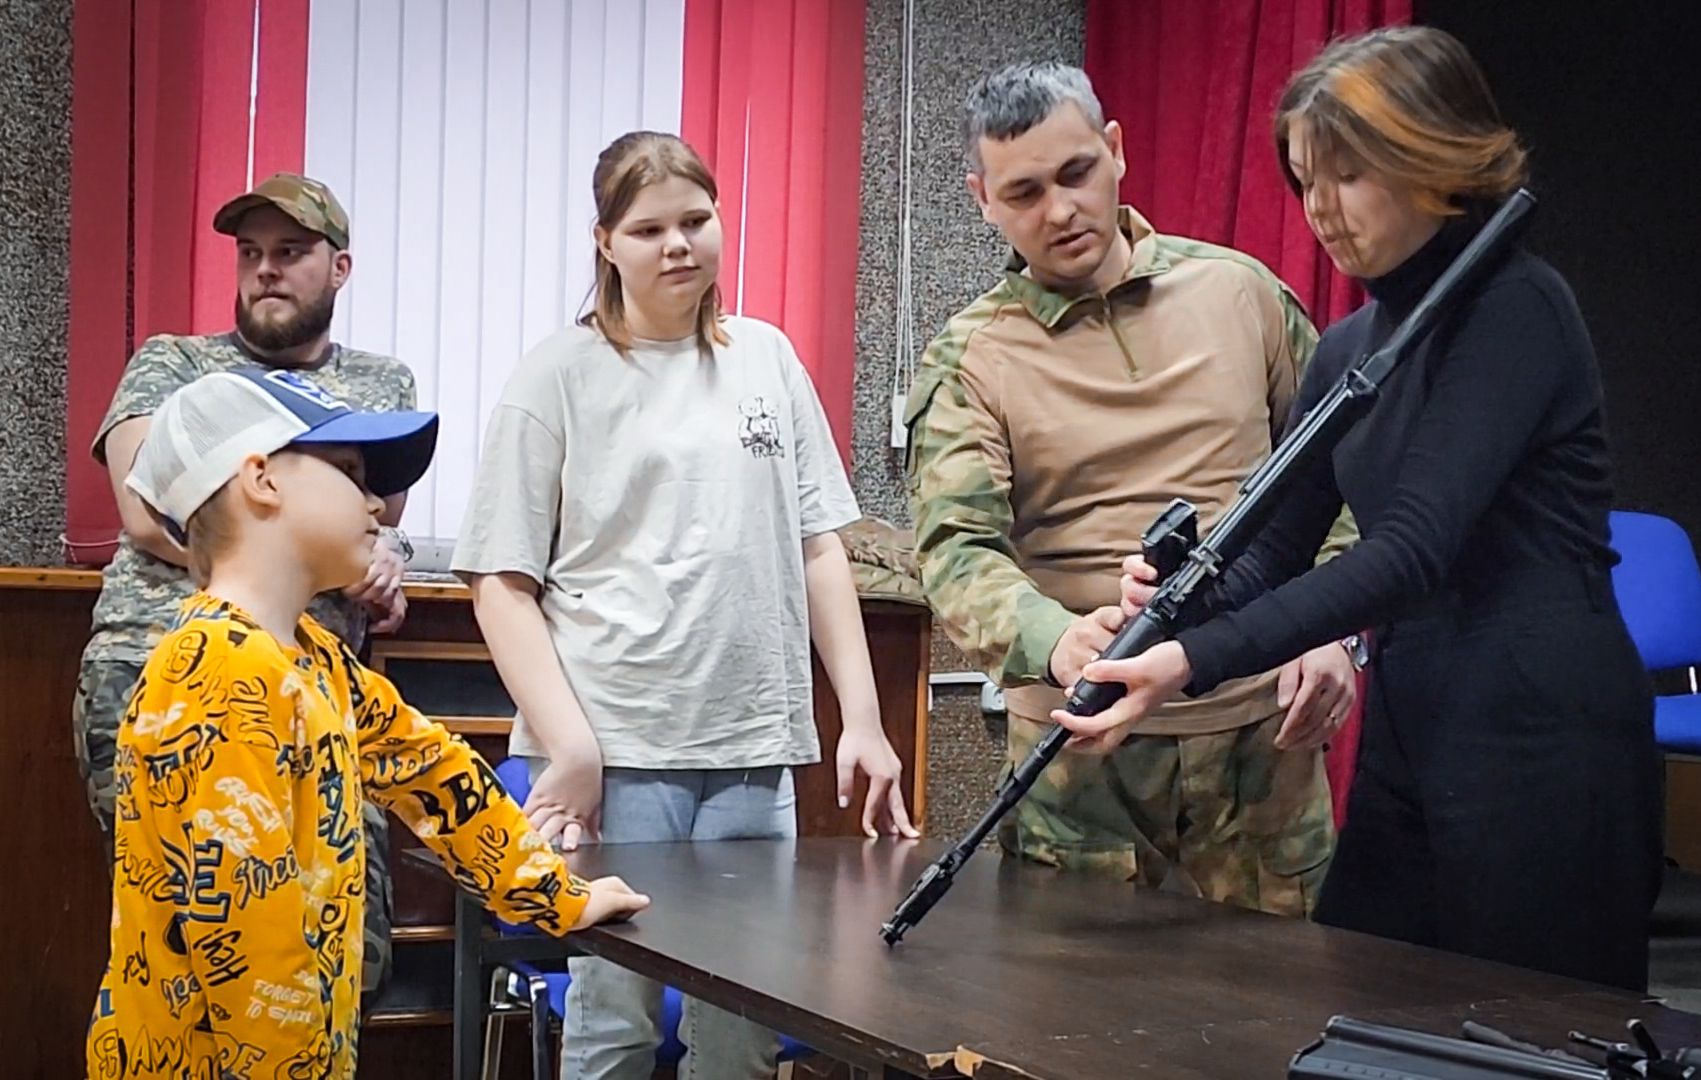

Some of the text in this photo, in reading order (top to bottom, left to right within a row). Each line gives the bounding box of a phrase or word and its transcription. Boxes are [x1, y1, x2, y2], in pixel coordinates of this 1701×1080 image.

[193, 927, 250, 987] Hey!
[253, 978, 315, 1007] FORGET
[246, 996, 267, 1020] TO
